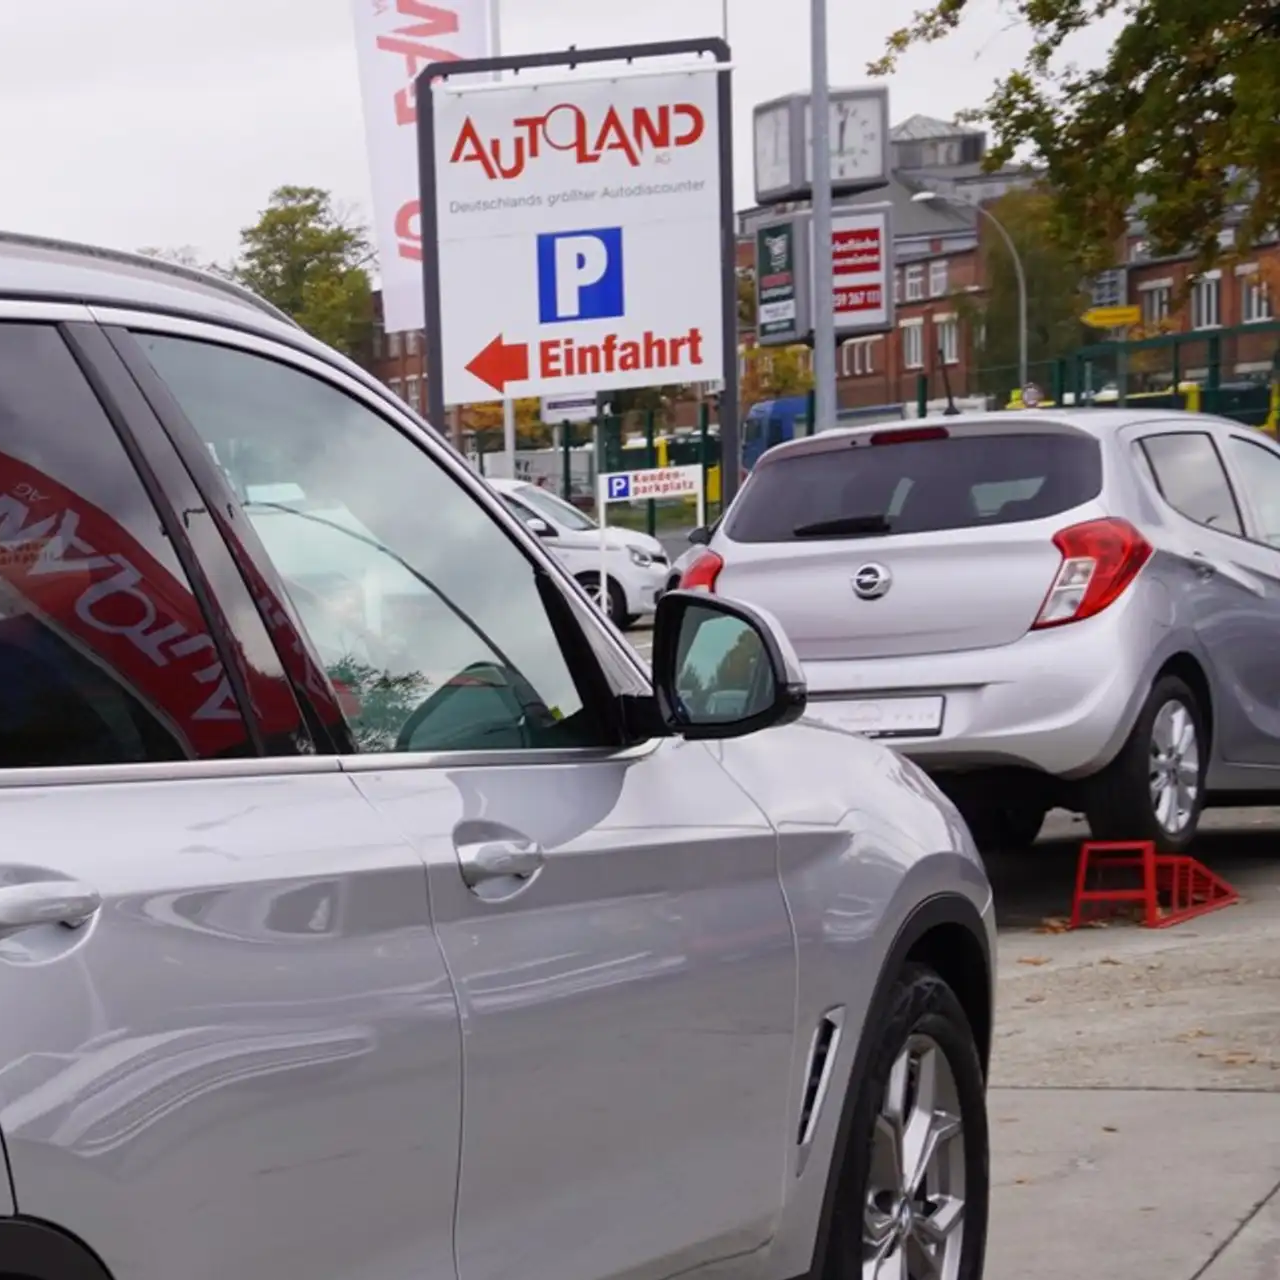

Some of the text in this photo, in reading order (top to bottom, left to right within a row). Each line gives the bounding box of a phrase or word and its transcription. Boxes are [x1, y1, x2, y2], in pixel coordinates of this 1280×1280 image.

[448, 103, 705, 180] AUTOLAND
[449, 193, 543, 214] Deutschlands
[602, 179, 706, 199] Autodiscounter
[554, 234, 609, 318] P
[539, 327, 704, 379] Einfahrt
[632, 481, 694, 496] parkplatz
